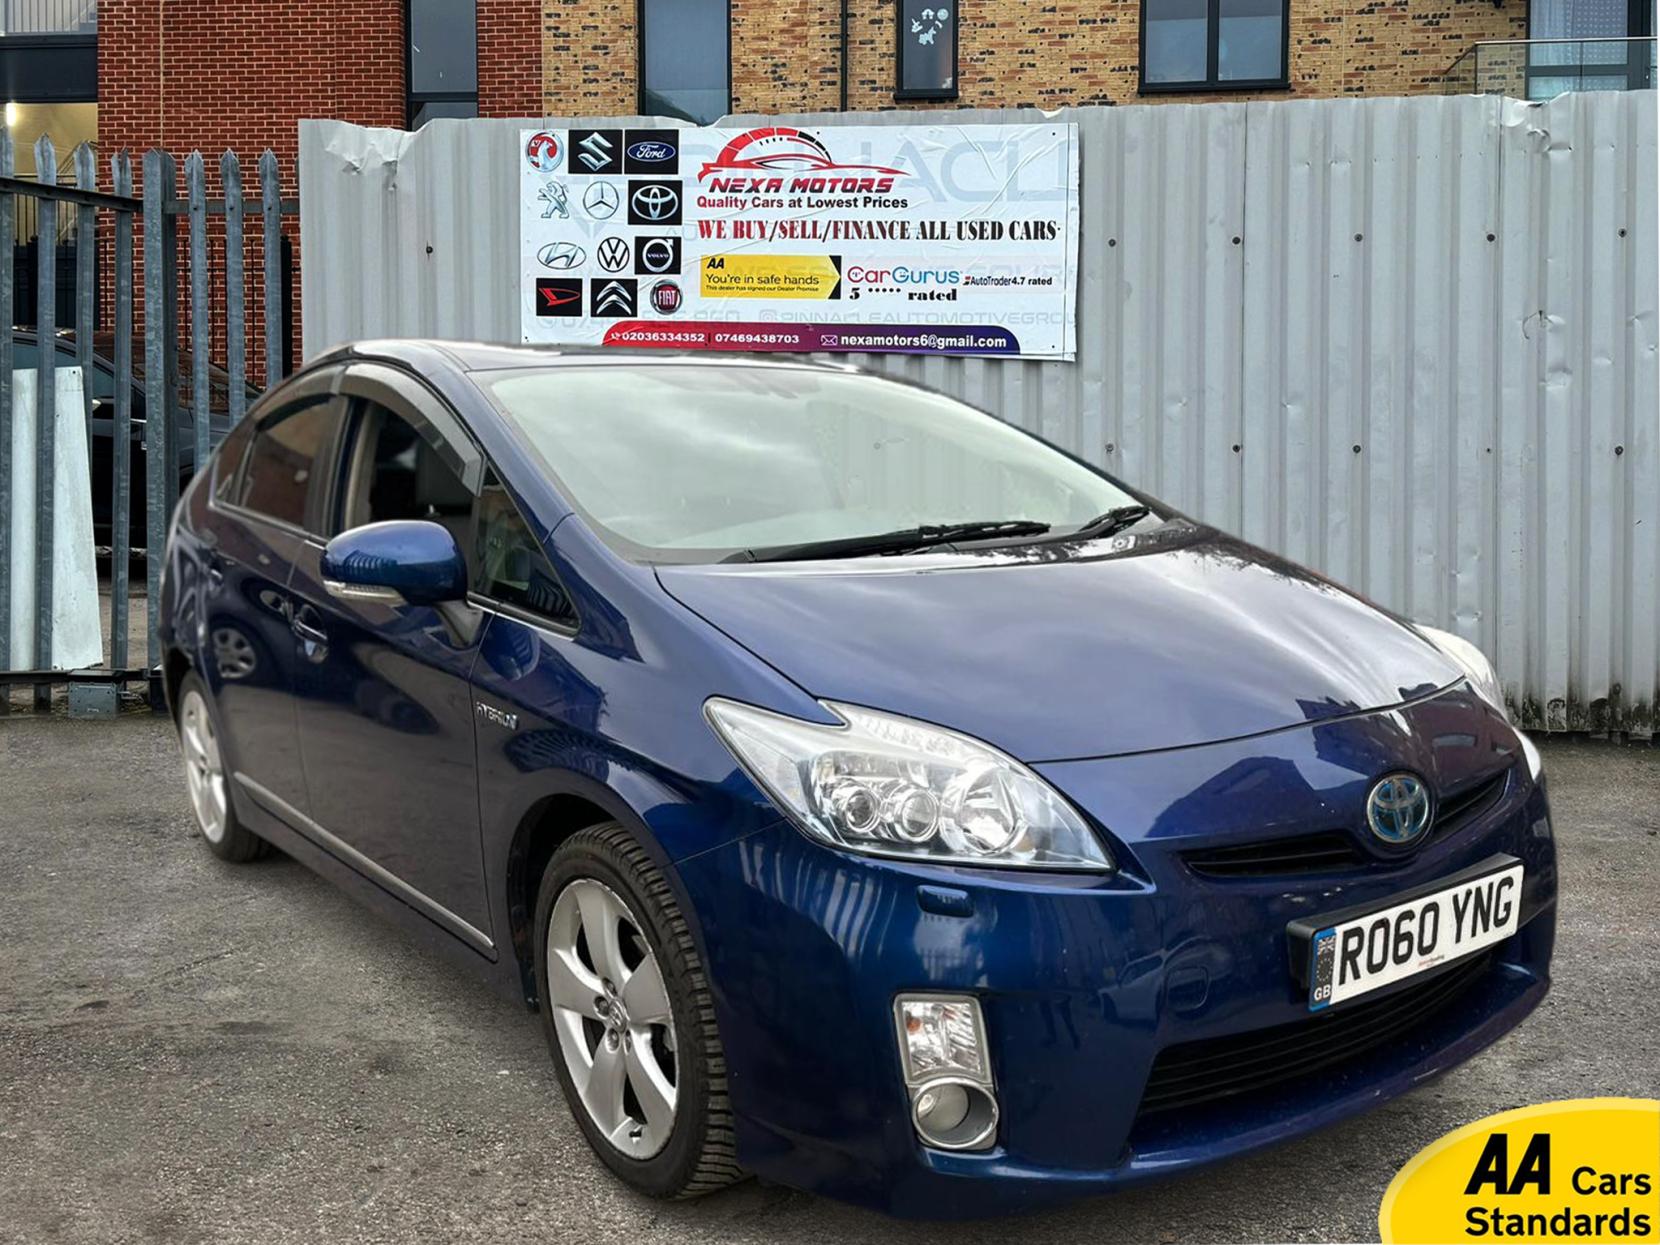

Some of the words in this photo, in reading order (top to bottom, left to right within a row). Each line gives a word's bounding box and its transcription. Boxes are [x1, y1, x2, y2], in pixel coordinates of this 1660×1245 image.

[636, 144, 667, 159] Ford
[709, 178, 784, 193] NEXA
[789, 178, 894, 193] MOTORS
[697, 196, 747, 210] Quality
[752, 197, 784, 208] Cars
[788, 197, 803, 208] at
[807, 197, 859, 208] Lowest
[863, 197, 908, 208] Prices
[697, 220, 727, 240] WE
[916, 220, 951, 241] ALL
[956, 220, 1004, 241] USED
[1008, 219, 1057, 241] CARS
[706, 258, 725, 270] AA
[706, 274, 741, 285] You're
[744, 274, 754, 285] in
[757, 274, 781, 286] safe
[784, 275, 820, 286] hands
[1028, 277, 1052, 286] rated
[658, 290, 676, 306] FIAT
[849, 287, 861, 300] 5
[908, 288, 958, 301] rated
[622, 332, 705, 342] 02036334352
[715, 333, 800, 344] 07469438703
[841, 334, 1007, 350] nexamotors6@gmail.com
[1338, 901, 1440, 986] RO60
[1452, 876, 1514, 944] YNG
[1313, 984, 1332, 1001] GB
